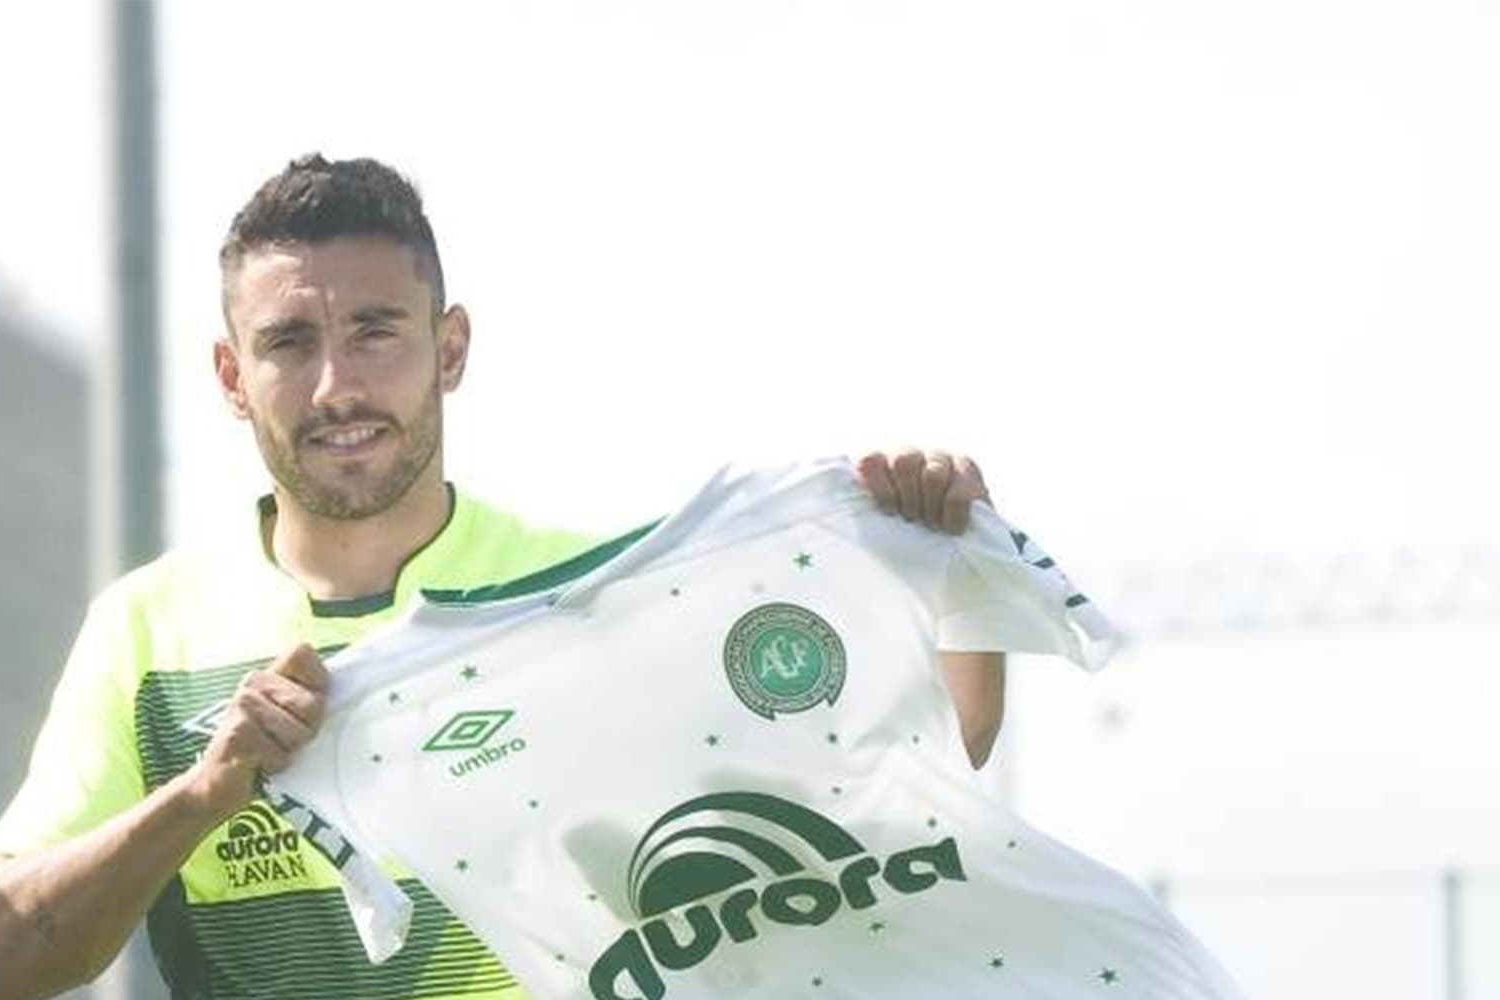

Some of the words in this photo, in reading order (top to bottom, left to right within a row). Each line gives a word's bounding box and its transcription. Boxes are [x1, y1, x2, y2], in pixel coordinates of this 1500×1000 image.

[449, 737, 527, 778] umbro
[215, 829, 299, 863] aurora
[224, 855, 308, 889] HAVAN
